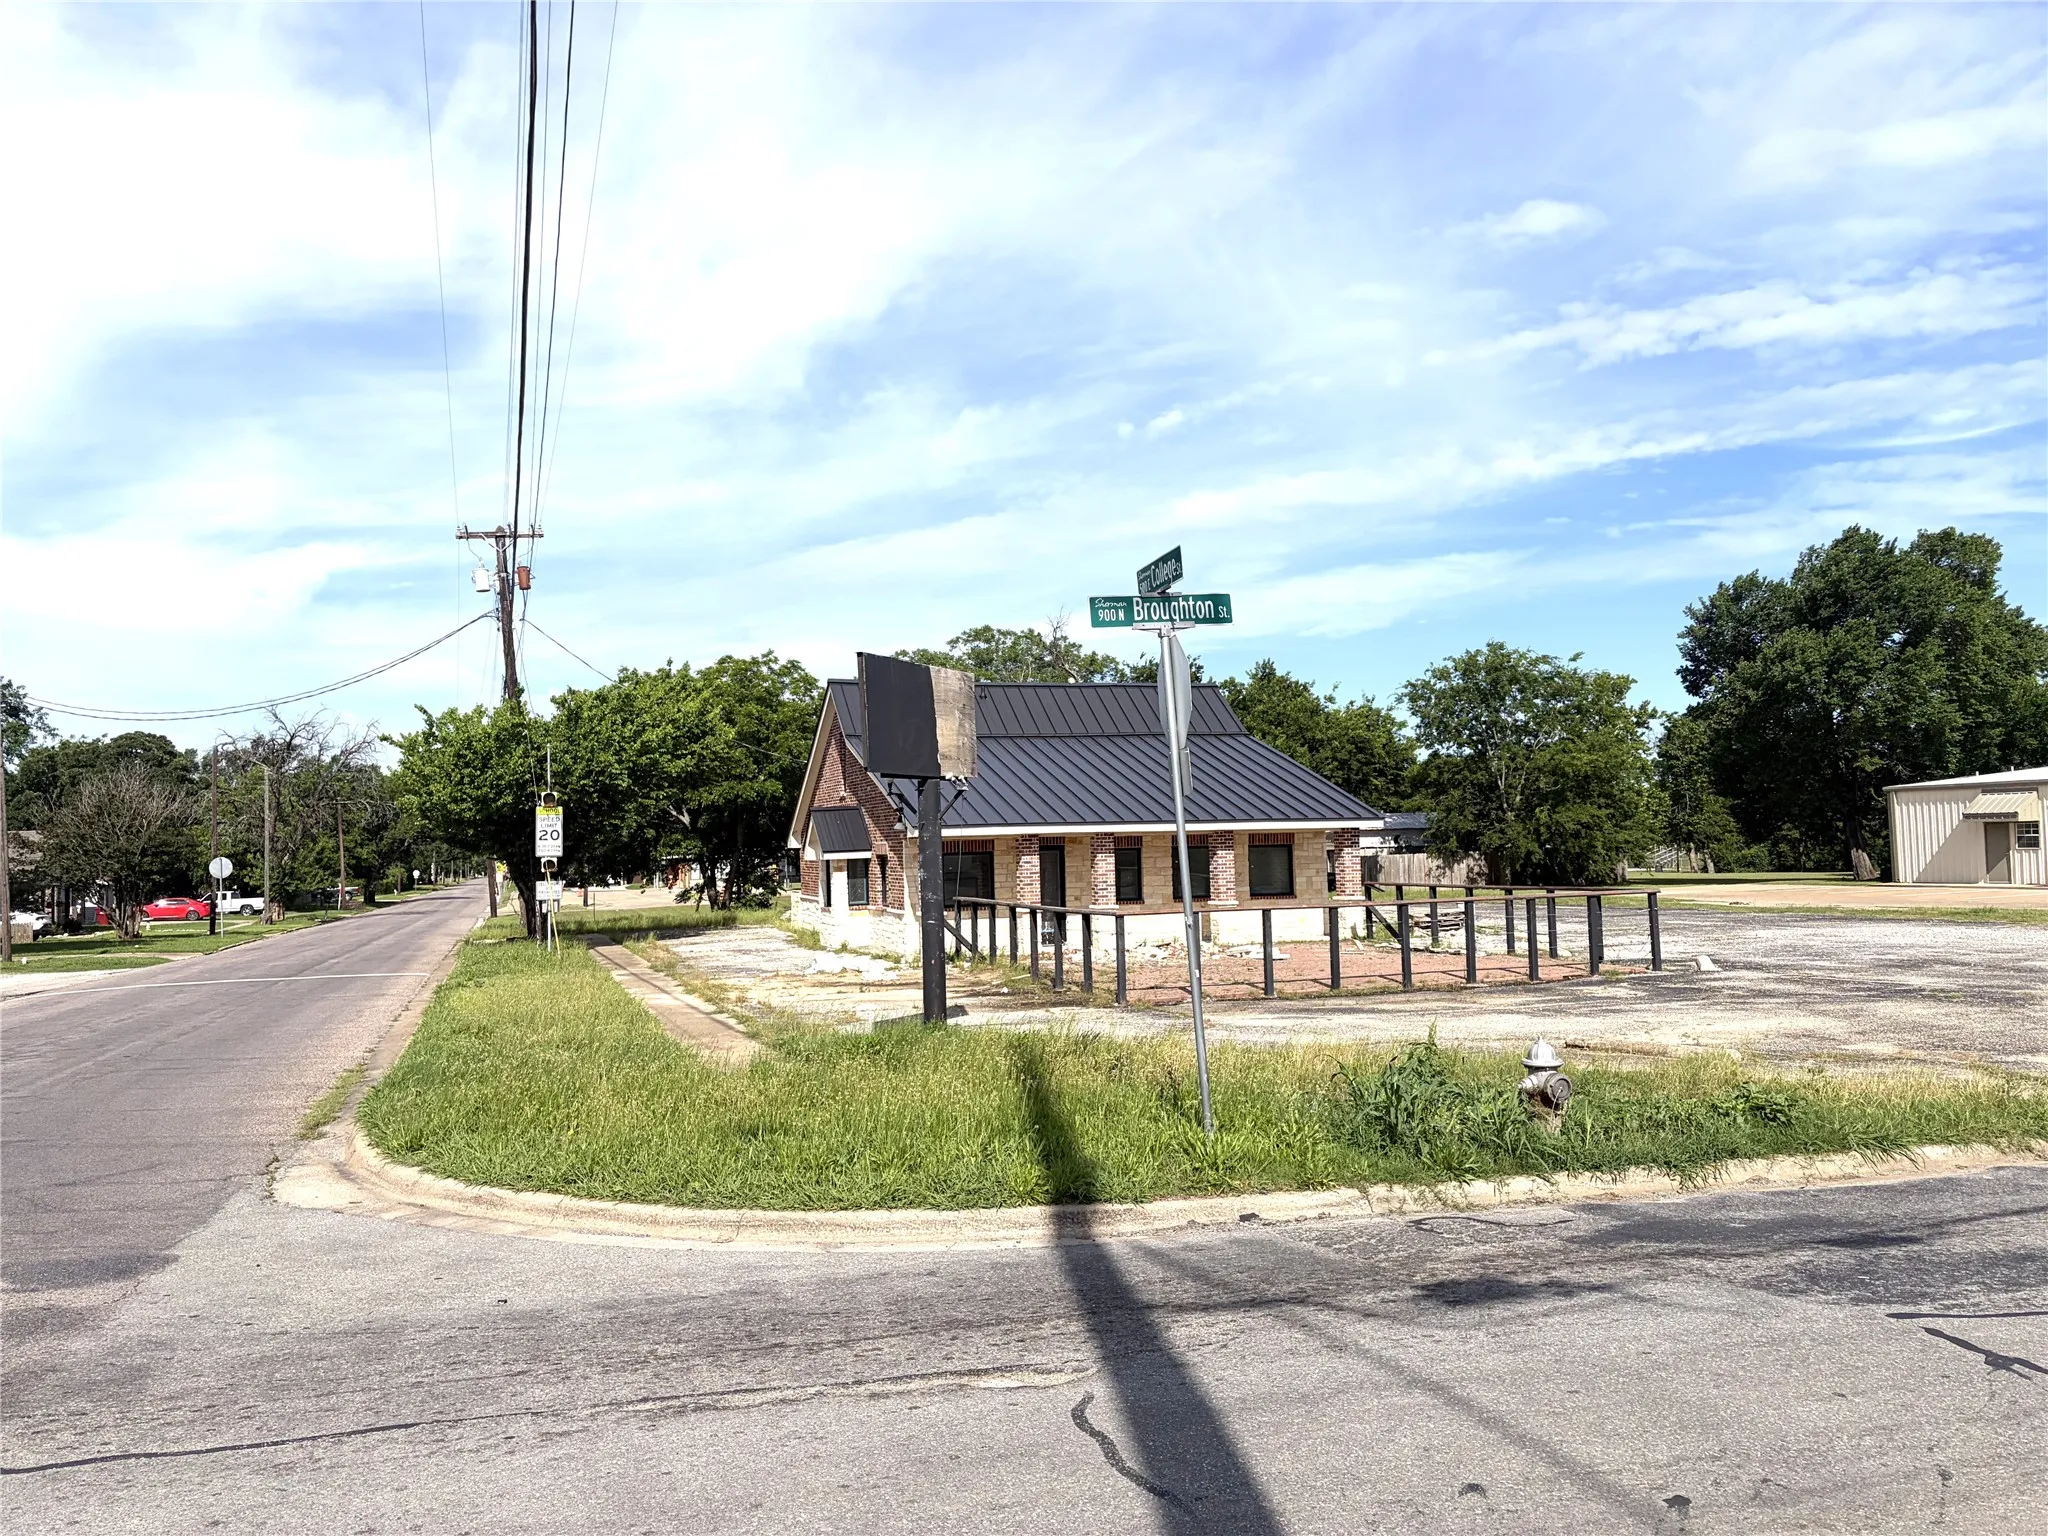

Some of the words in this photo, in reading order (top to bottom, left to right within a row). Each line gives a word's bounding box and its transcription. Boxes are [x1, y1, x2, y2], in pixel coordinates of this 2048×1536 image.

[1150, 558, 1176, 588] College
[1098, 609, 1116, 621] 900
[1118, 609, 1125, 621] N
[1132, 596, 1214, 623] Broughton
[538, 829, 560, 841] 20
